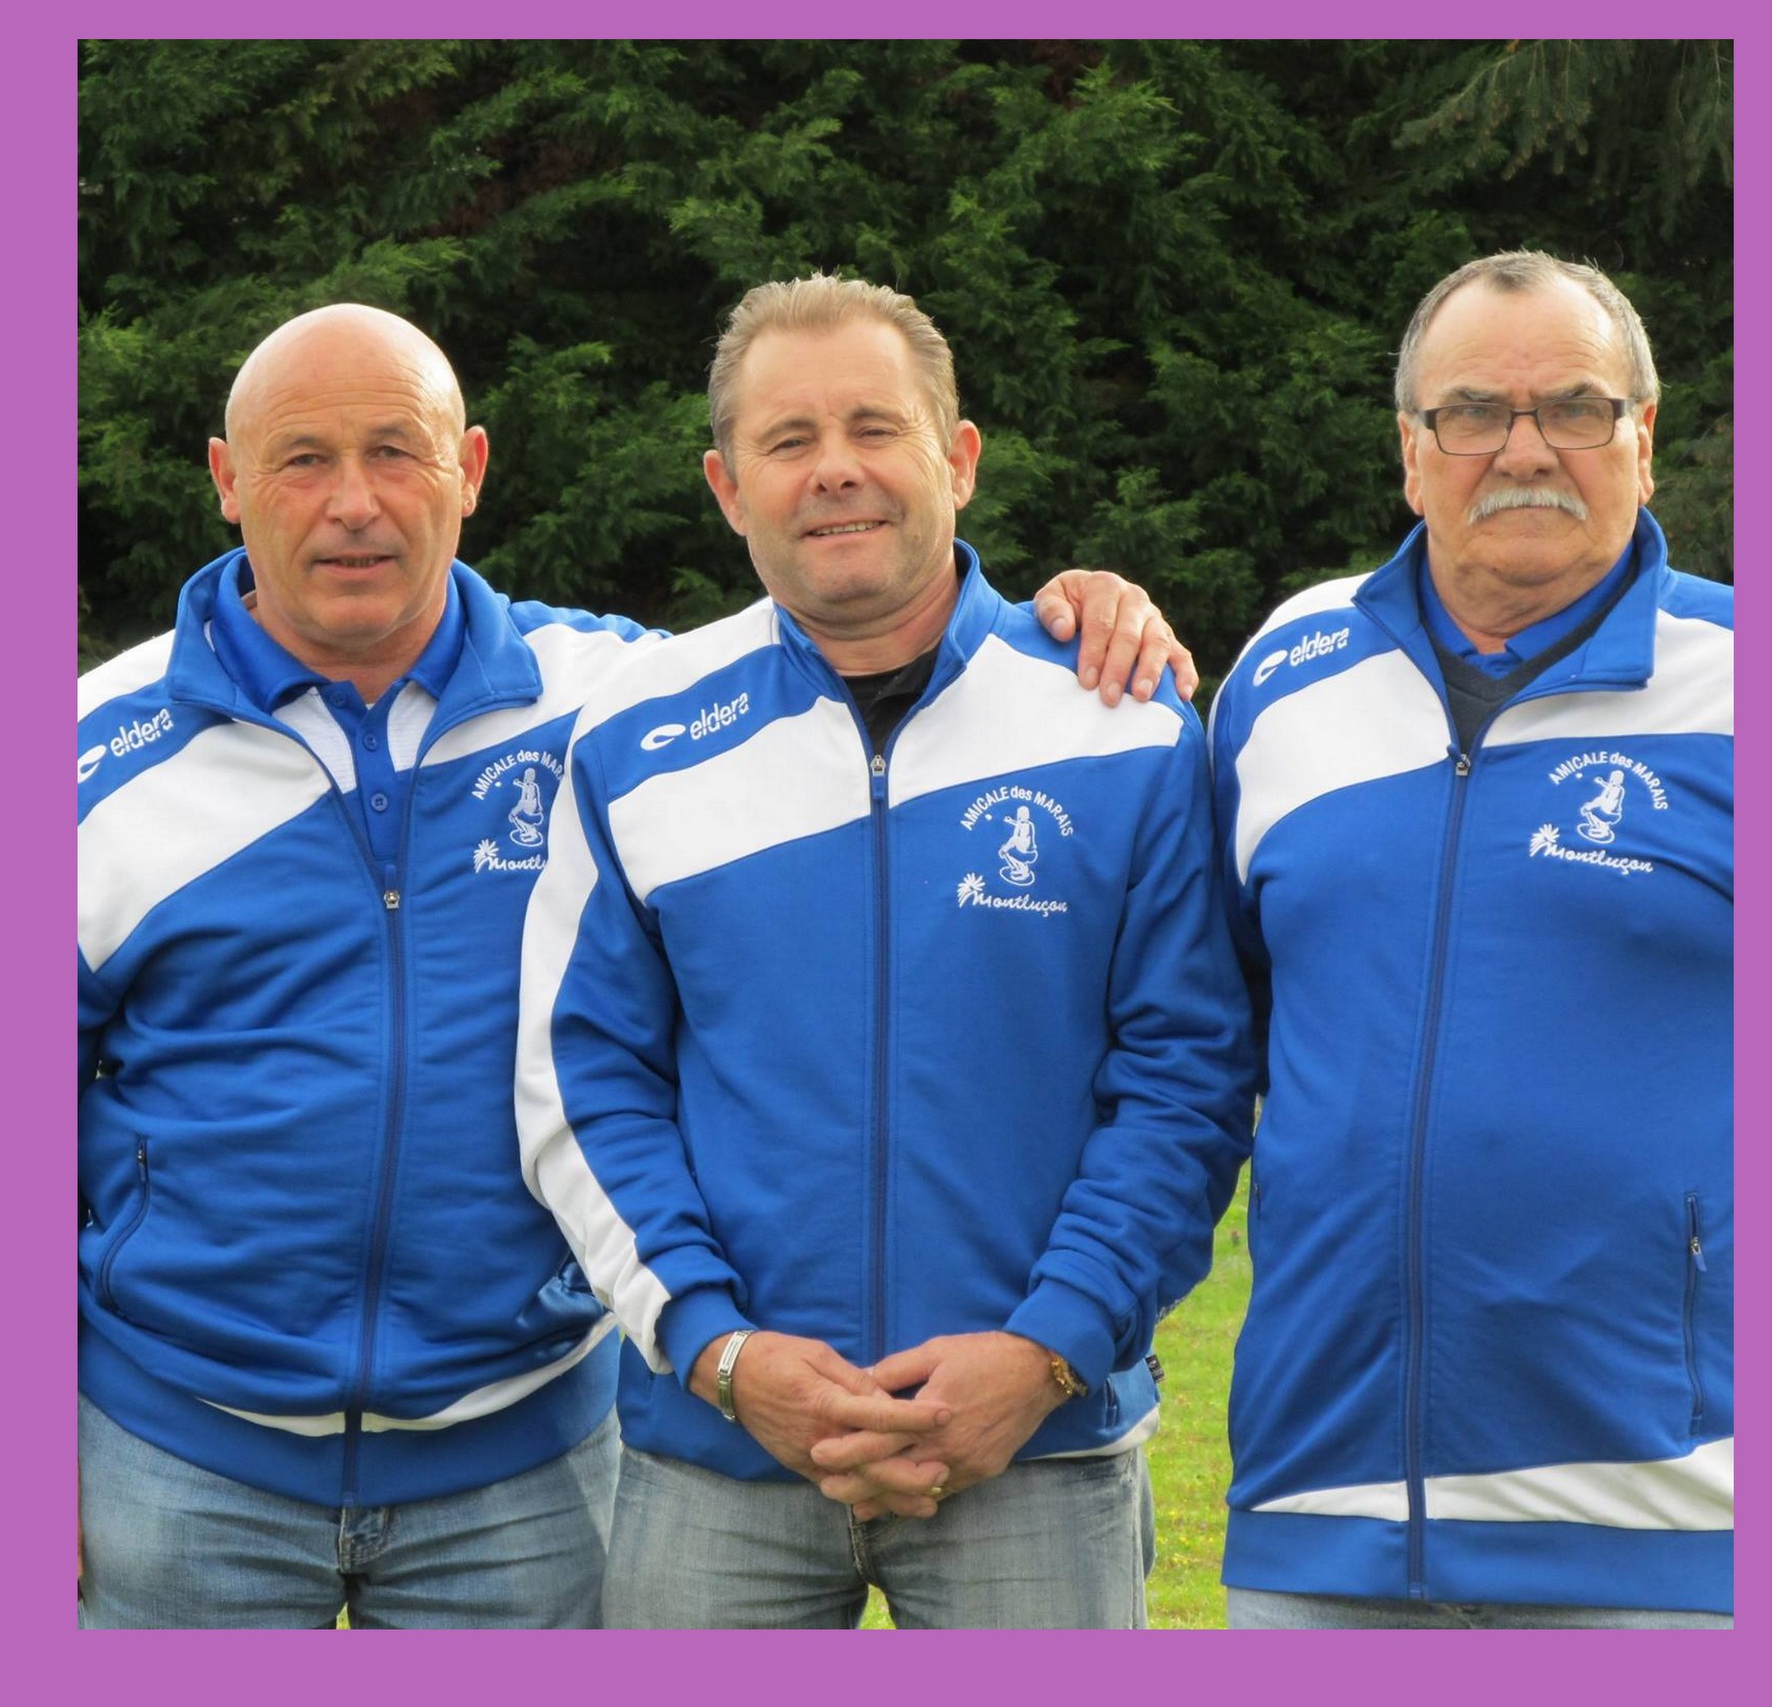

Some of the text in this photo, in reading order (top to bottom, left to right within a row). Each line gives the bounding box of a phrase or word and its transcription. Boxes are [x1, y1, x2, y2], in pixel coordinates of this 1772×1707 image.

[1290, 627, 1350, 667] eldera
[110, 708, 174, 757] eldera
[690, 692, 749, 740] eldera
[471, 754, 517, 800] AMICALE
[517, 749, 539, 762] des
[1548, 751, 1669, 810] AMICALE des MARAIS
[960, 785, 1074, 836] AMICALE des MARAIS
[1530, 841, 1654, 875] Montluçon
[958, 890, 1068, 917] Montluçon
